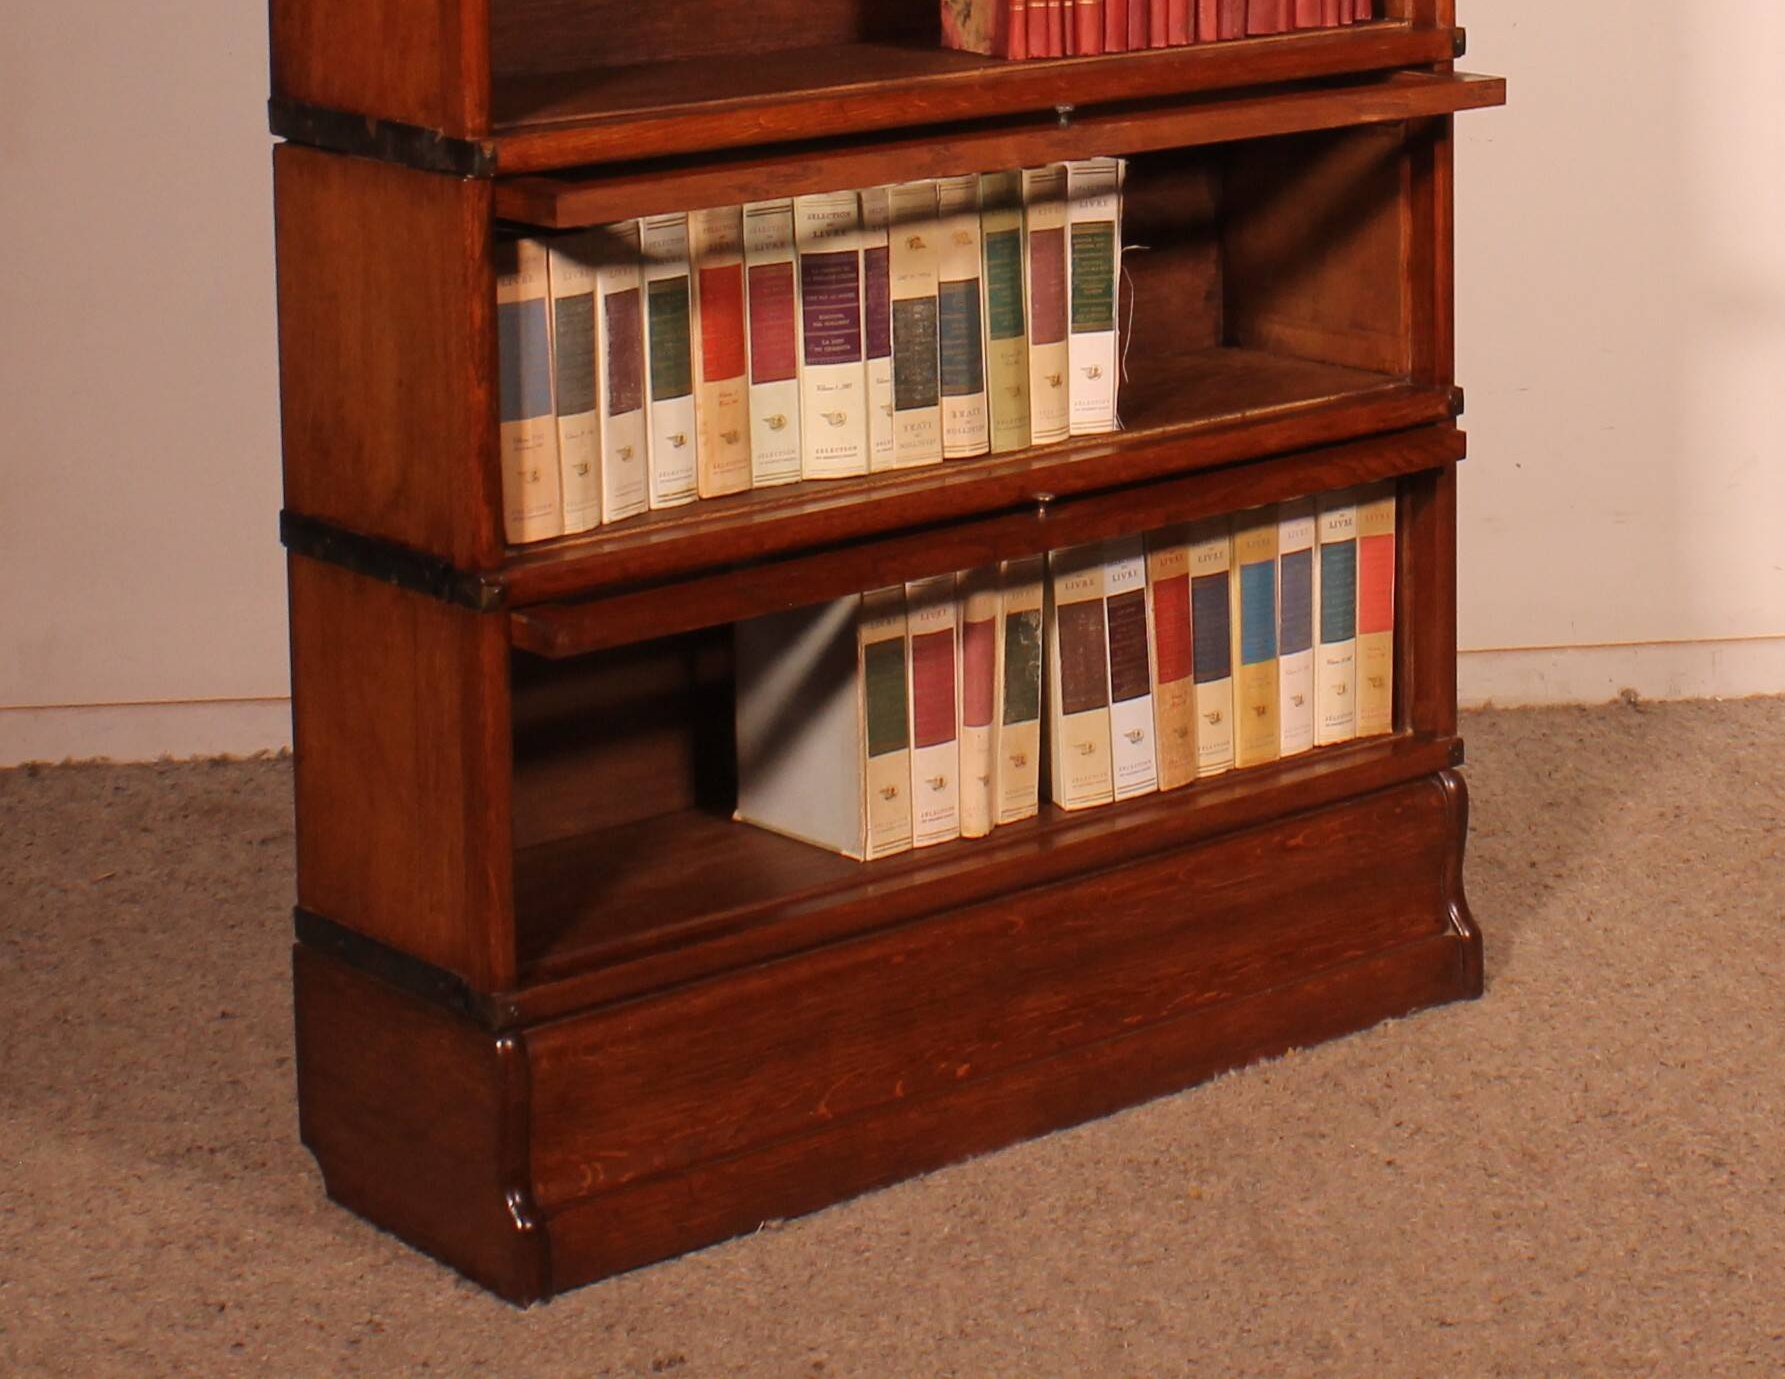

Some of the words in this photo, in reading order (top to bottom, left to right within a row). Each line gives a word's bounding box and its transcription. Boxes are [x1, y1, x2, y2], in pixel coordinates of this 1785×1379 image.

[812, 229, 848, 239] LIVRE
[754, 242, 786, 252] LIVRE
[1329, 518, 1352, 529] LIVRE
[1198, 551, 1224, 563] LIVRE
[1112, 570, 1138, 582] LIVRE
[1065, 578, 1094, 590] LIVRE
[920, 609, 946, 621] LIVRE
